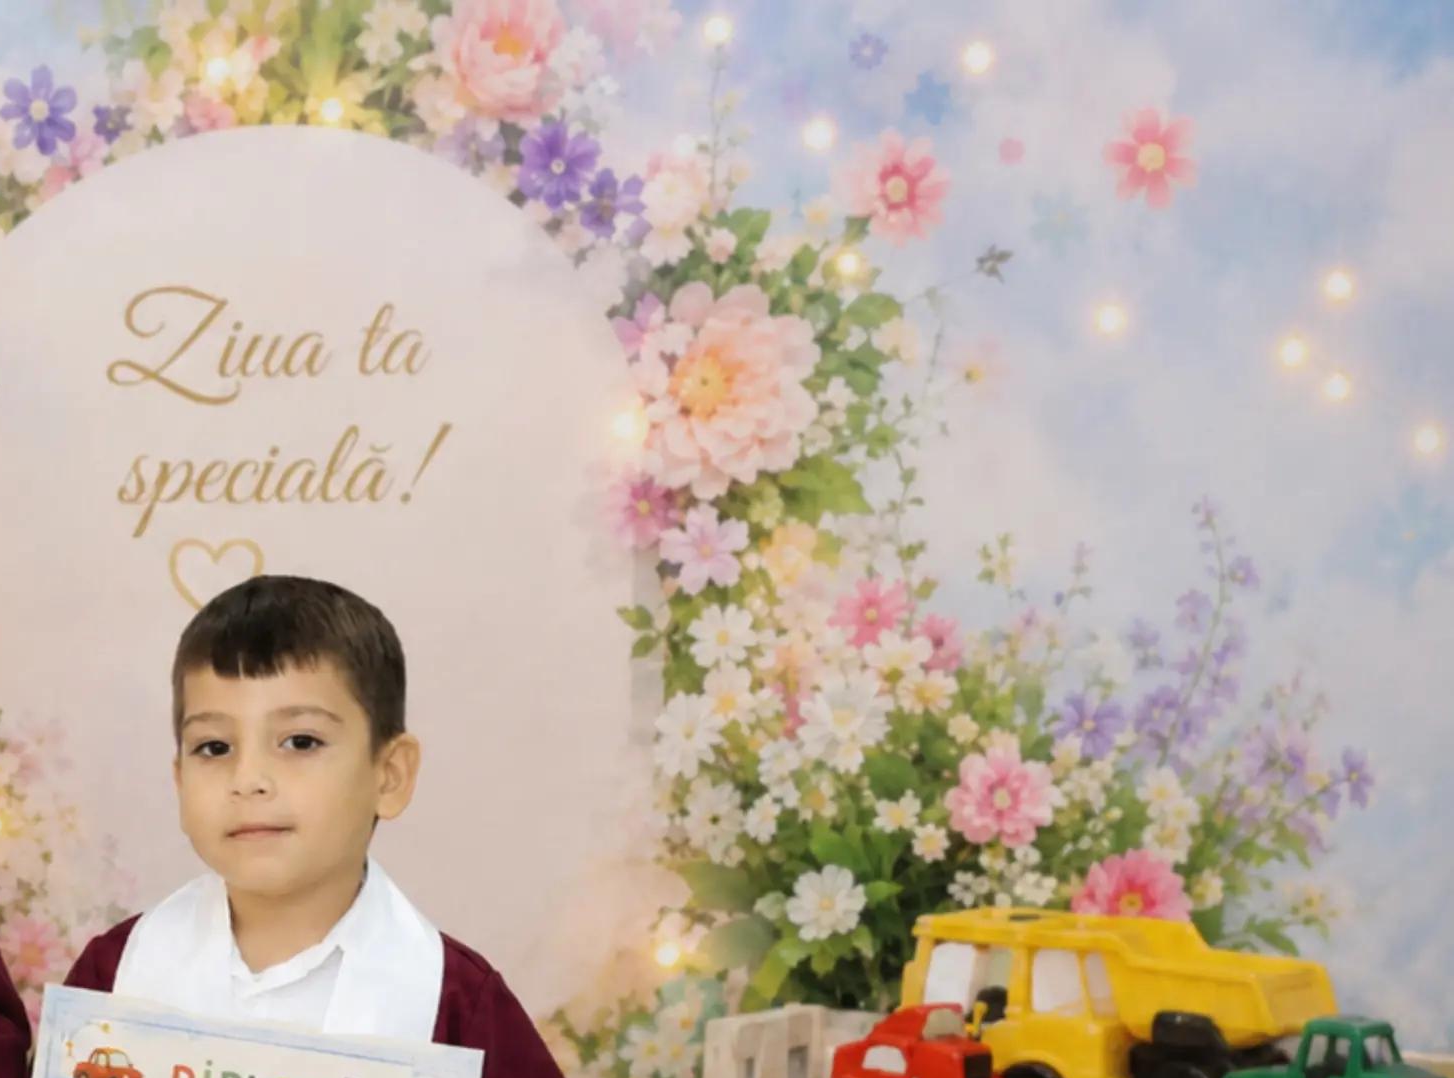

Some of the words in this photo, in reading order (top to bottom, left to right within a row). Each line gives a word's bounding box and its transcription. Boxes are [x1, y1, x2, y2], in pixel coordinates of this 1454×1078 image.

[106, 285, 333, 406] Ziua
[358, 302, 432, 376] ta
[117, 422, 452, 538] specială!
